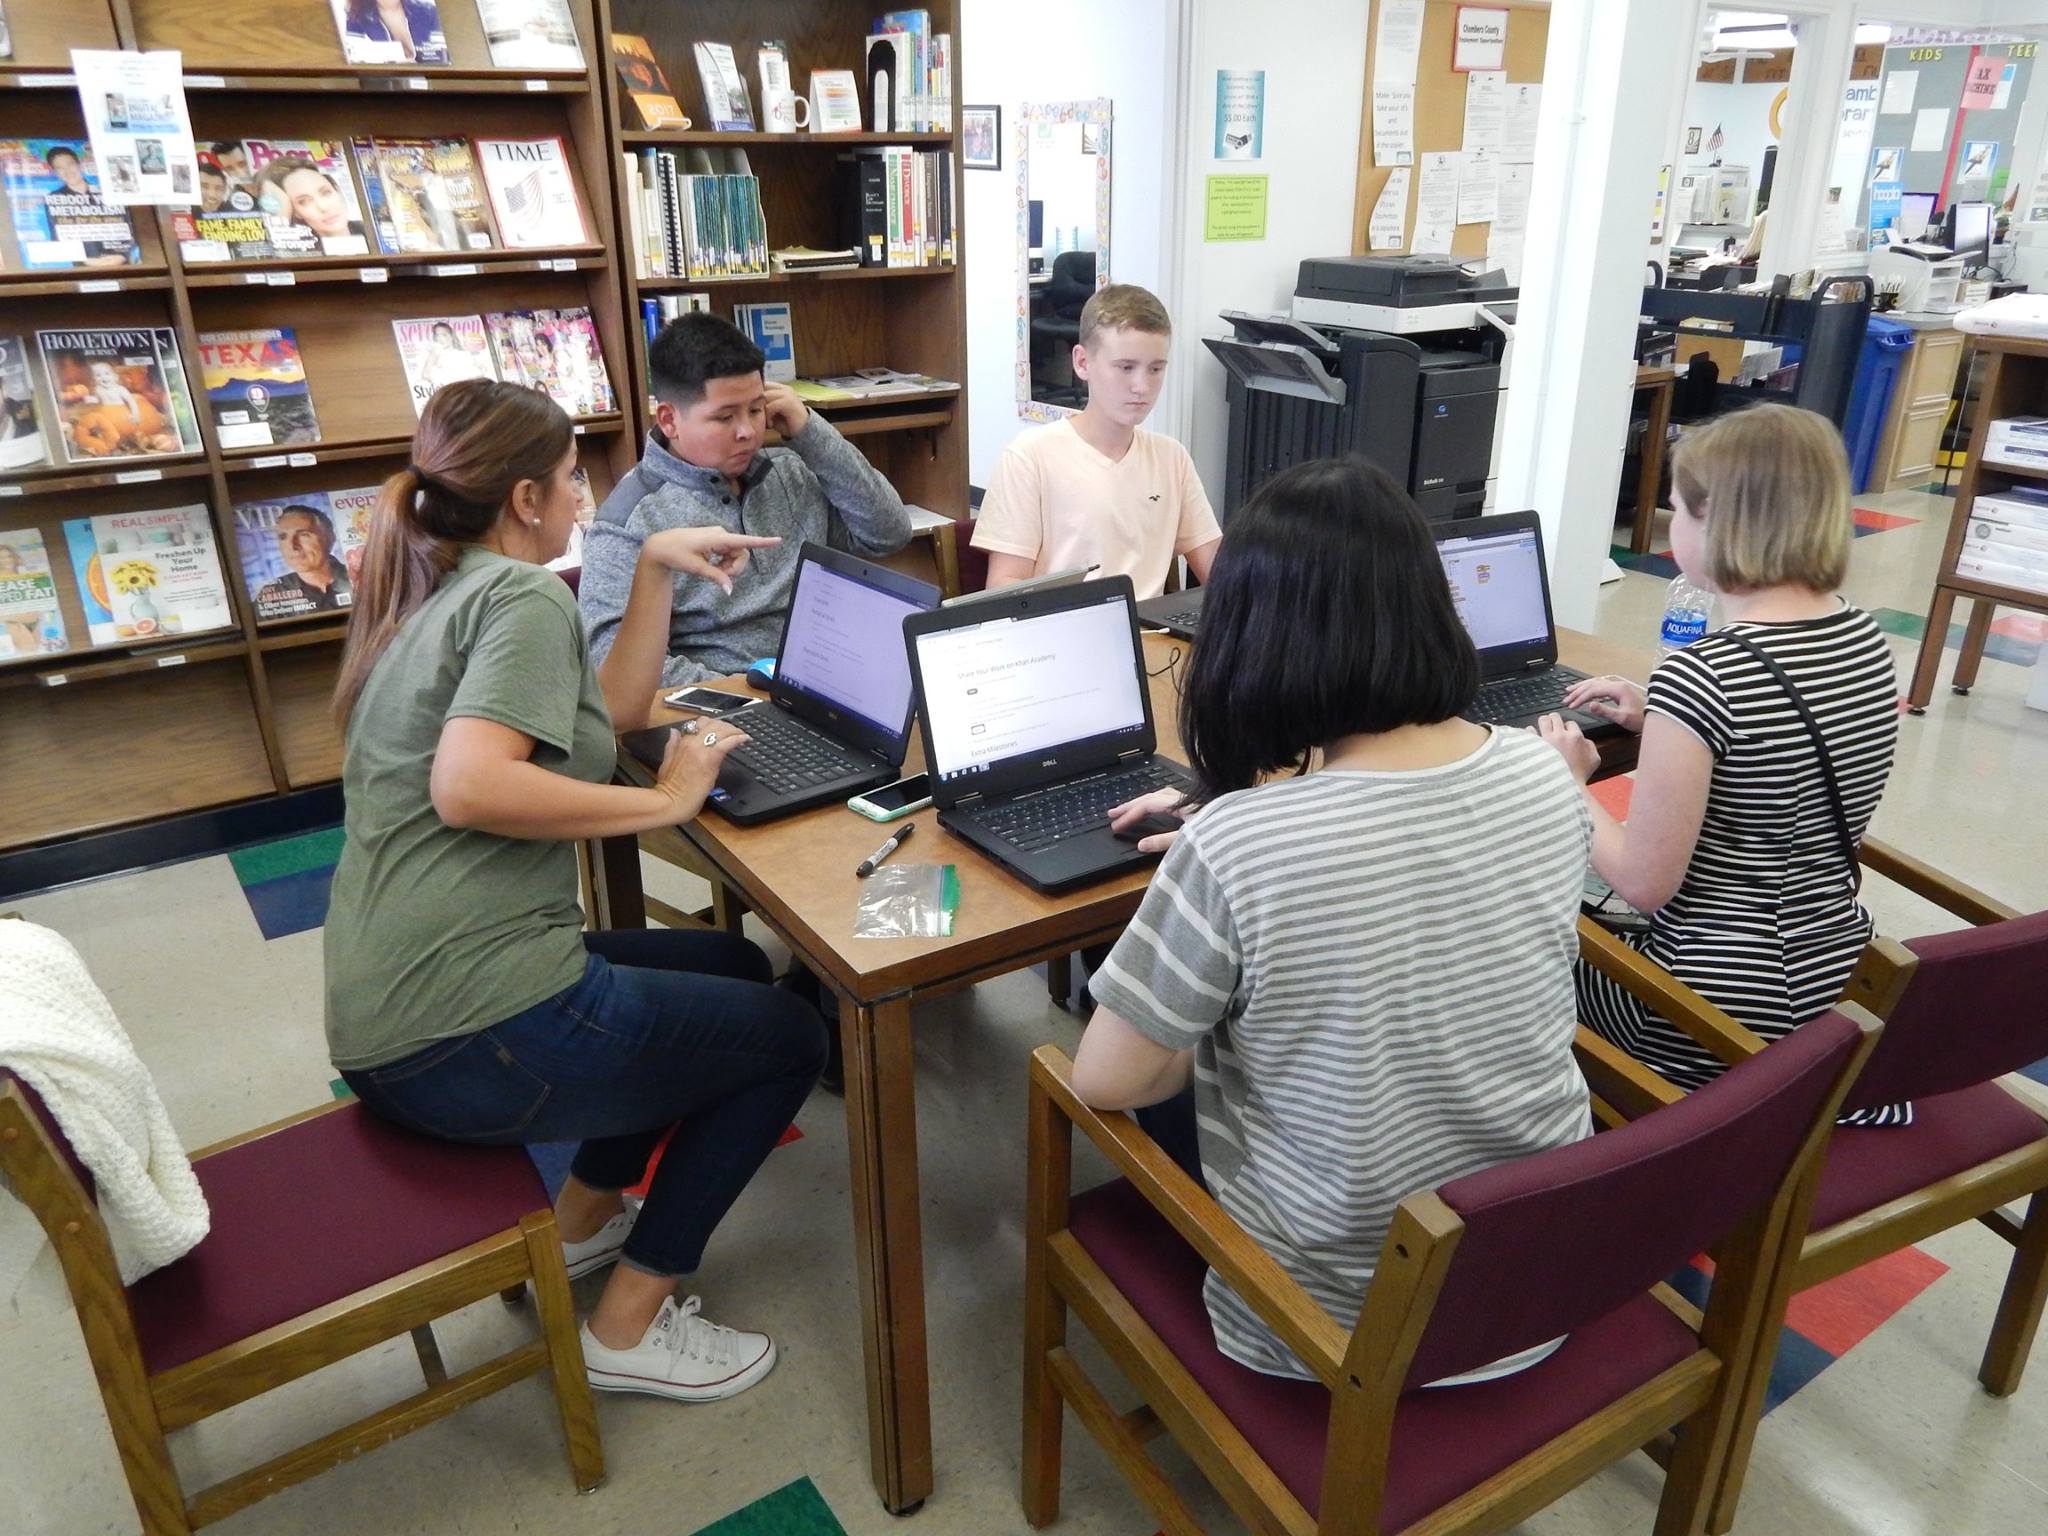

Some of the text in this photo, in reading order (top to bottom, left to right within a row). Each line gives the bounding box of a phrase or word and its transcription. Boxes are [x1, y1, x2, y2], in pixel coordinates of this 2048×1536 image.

[1909, 49, 1943, 61] KIDS
[646, 104, 674, 116] 2017
[490, 142, 551, 161] TIME
[46, 194, 90, 205] REBOOT
[48, 205, 127, 217] METABOLISM
[227, 218, 262, 230] FAMILY
[247, 229, 265, 242] LOV
[43, 332, 150, 350] HOMETOWN
[198, 340, 296, 365] TEXAS
[112, 512, 190, 528] REAL SIMPLE
[236, 506, 283, 530] VIP
[155, 547, 206, 559] Freshen Up
[172, 557, 193, 565] Your
[171, 564, 198, 572] Home
[26, 588, 54, 600] FAT
[1667, 622, 1702, 635] AQUAFINA
[1042, 759, 1057, 768] DELL
